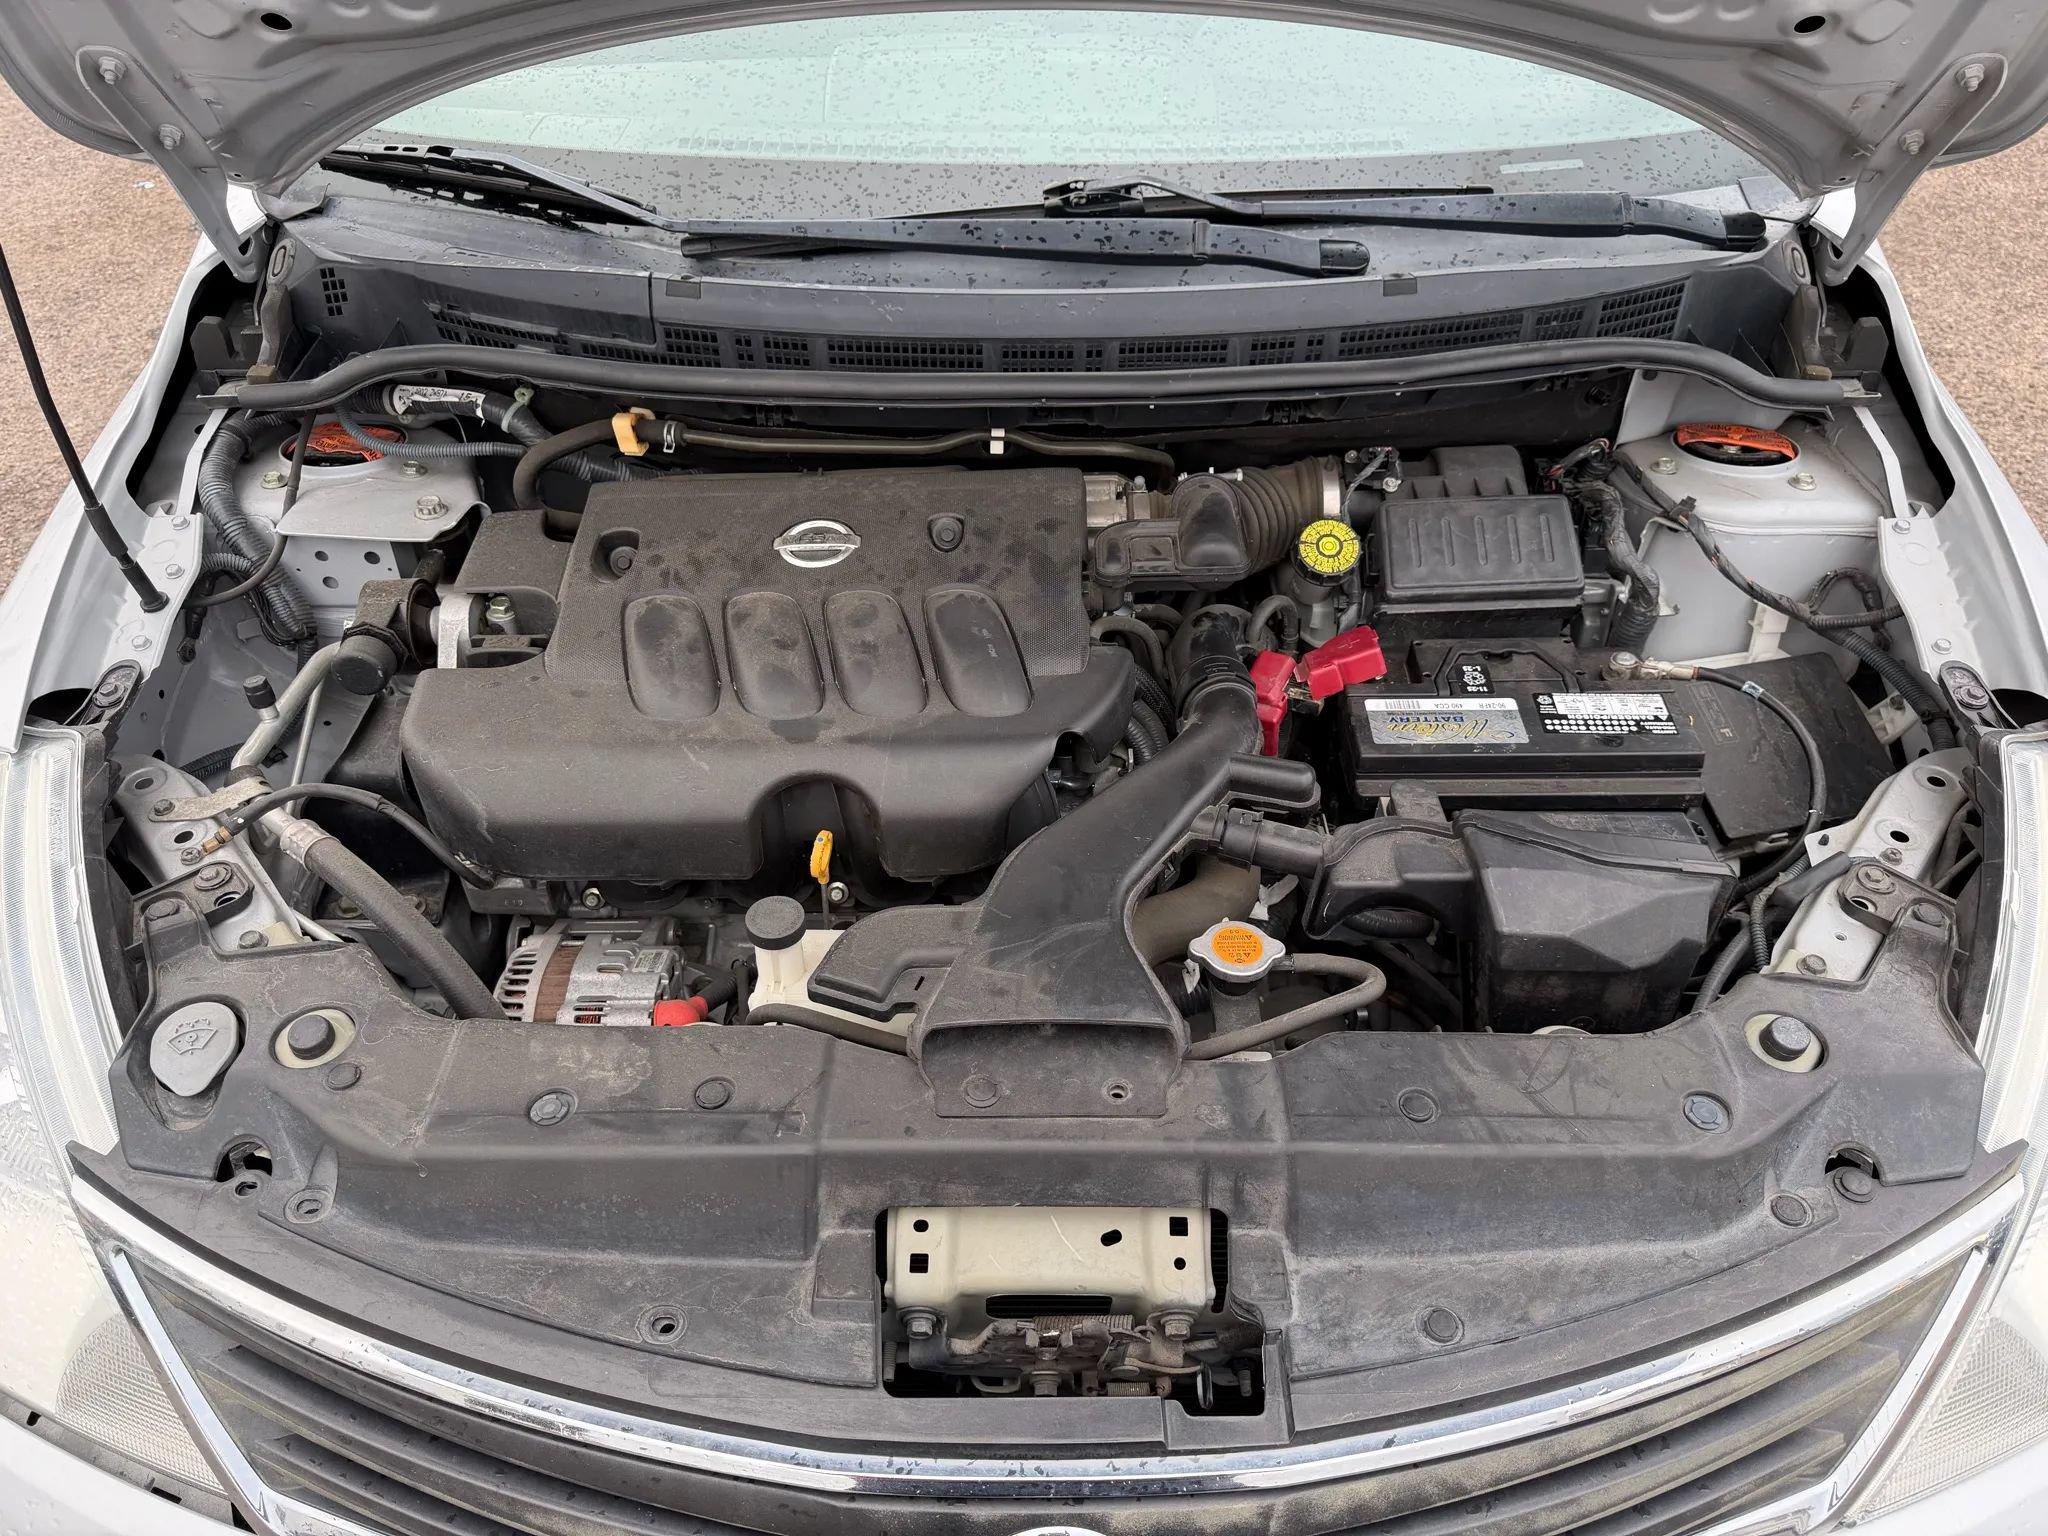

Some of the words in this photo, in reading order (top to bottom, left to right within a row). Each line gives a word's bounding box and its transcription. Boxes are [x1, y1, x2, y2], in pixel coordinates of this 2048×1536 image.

[782, 533, 850, 544] NISSAN
[1388, 715, 1465, 723] BATTERY
[1387, 719, 1491, 741] Western
